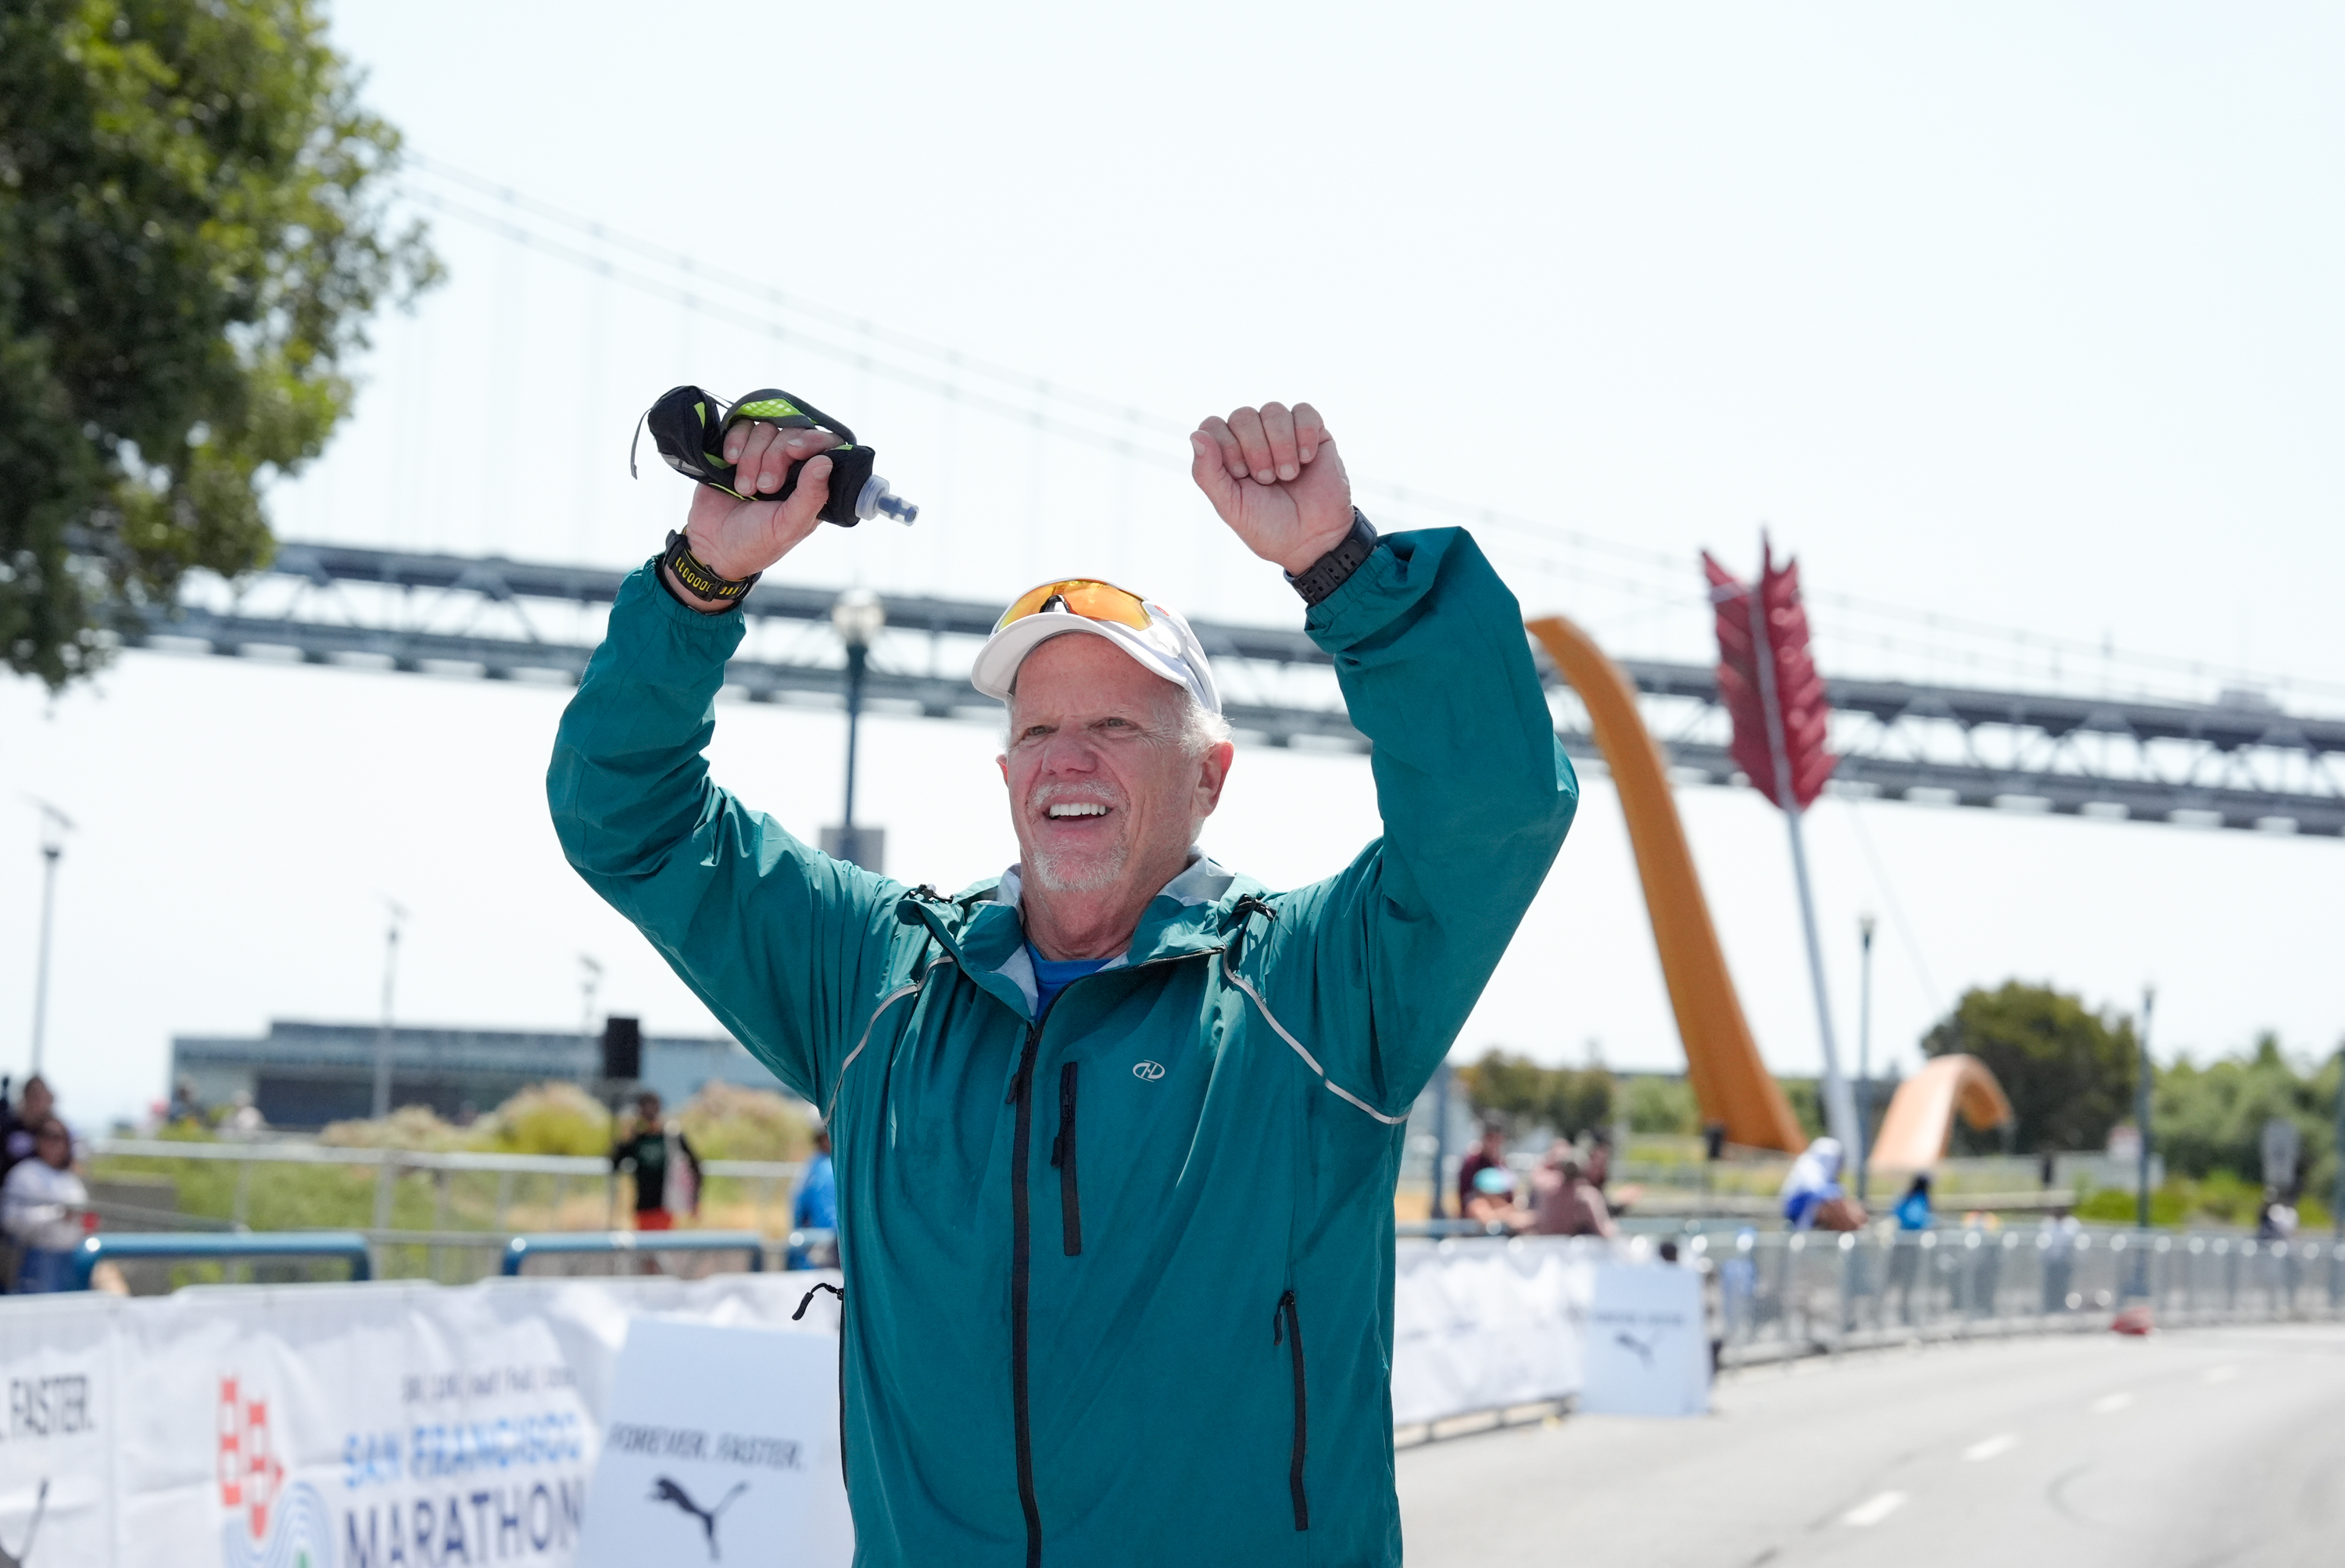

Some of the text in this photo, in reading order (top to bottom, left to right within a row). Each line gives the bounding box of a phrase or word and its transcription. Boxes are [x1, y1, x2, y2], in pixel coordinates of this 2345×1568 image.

[342, 1413, 580, 1488] SAN FRANCISCO
[345, 1476, 585, 1568] MARATHON
